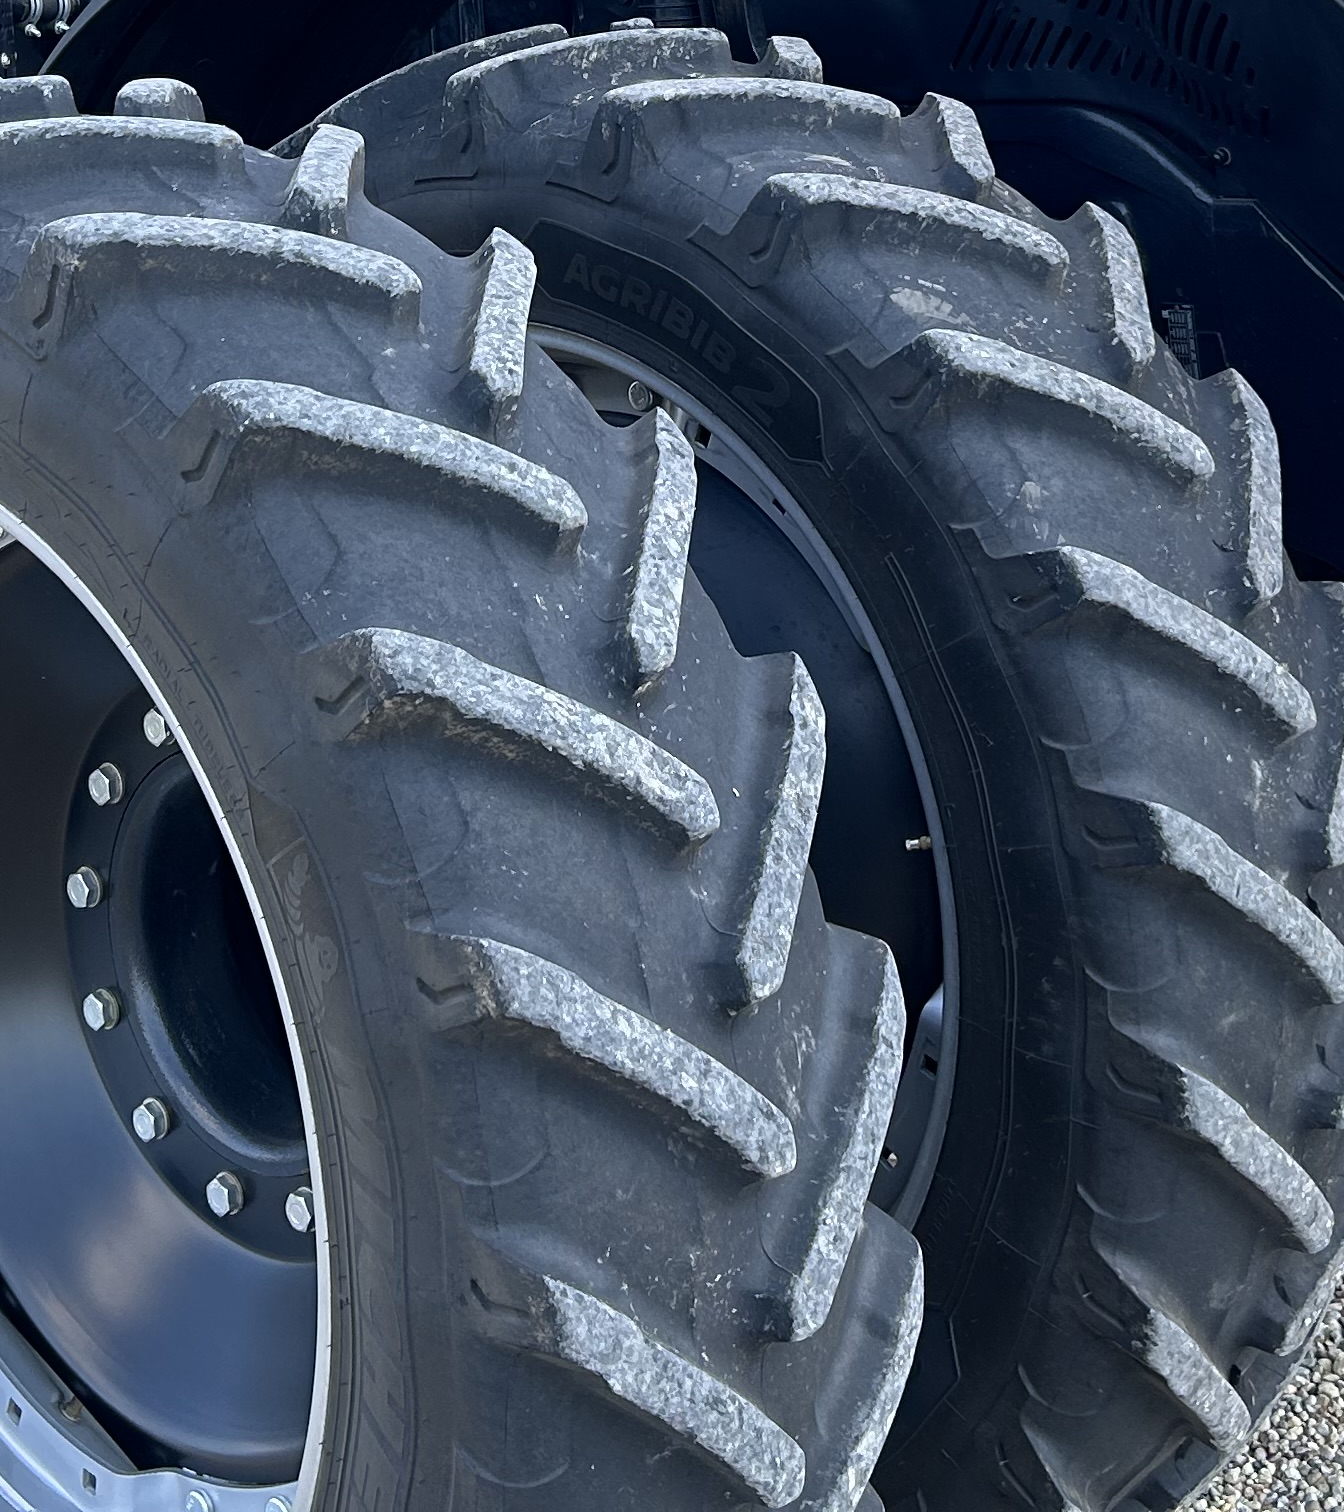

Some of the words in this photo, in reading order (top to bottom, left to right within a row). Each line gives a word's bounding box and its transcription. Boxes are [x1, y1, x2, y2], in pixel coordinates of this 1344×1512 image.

[563, 252, 737, 374] AGRIBIB
[730, 356, 791, 427] 2
[142, 633, 184, 702] RADIAL
